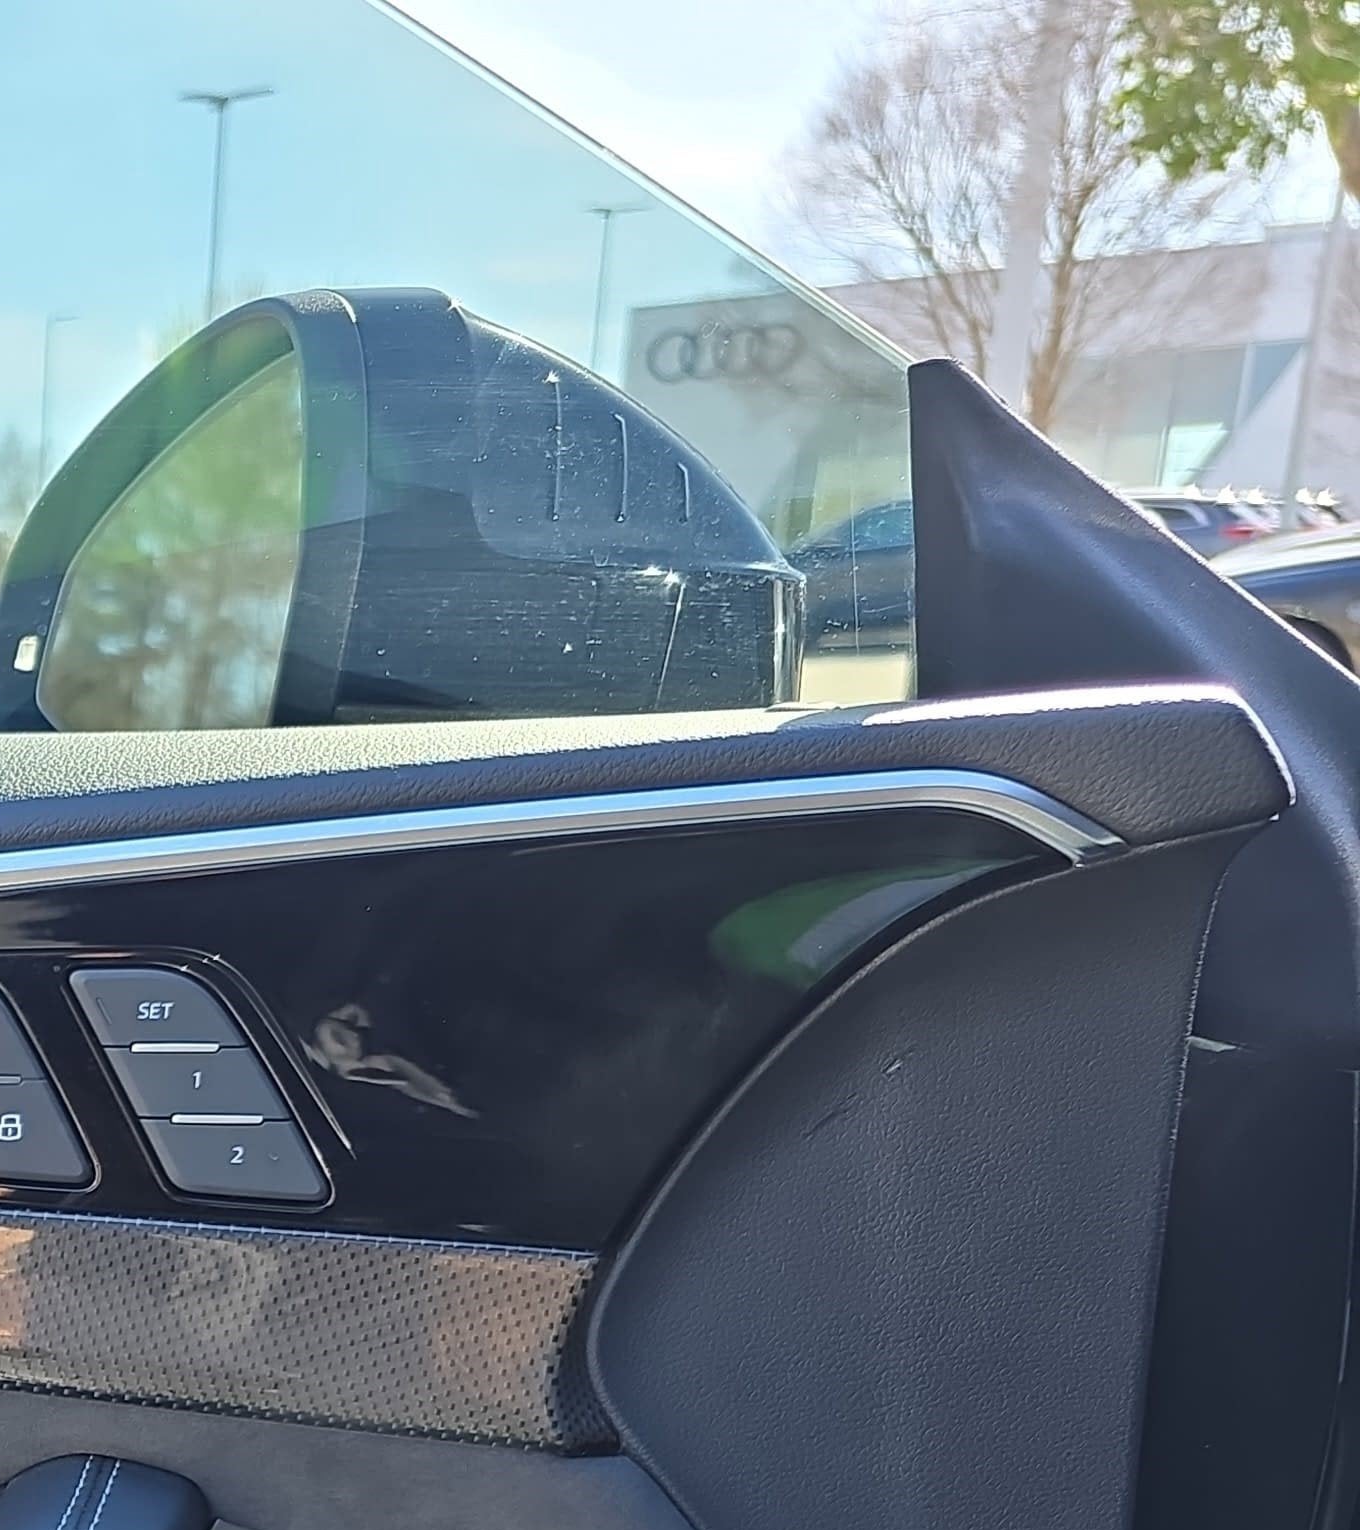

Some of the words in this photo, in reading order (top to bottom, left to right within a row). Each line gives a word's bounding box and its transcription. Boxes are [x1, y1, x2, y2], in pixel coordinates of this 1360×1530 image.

[137, 1001, 174, 1020] SET
[191, 1070, 202, 1089] 1
[229, 1145, 245, 1164] 2
